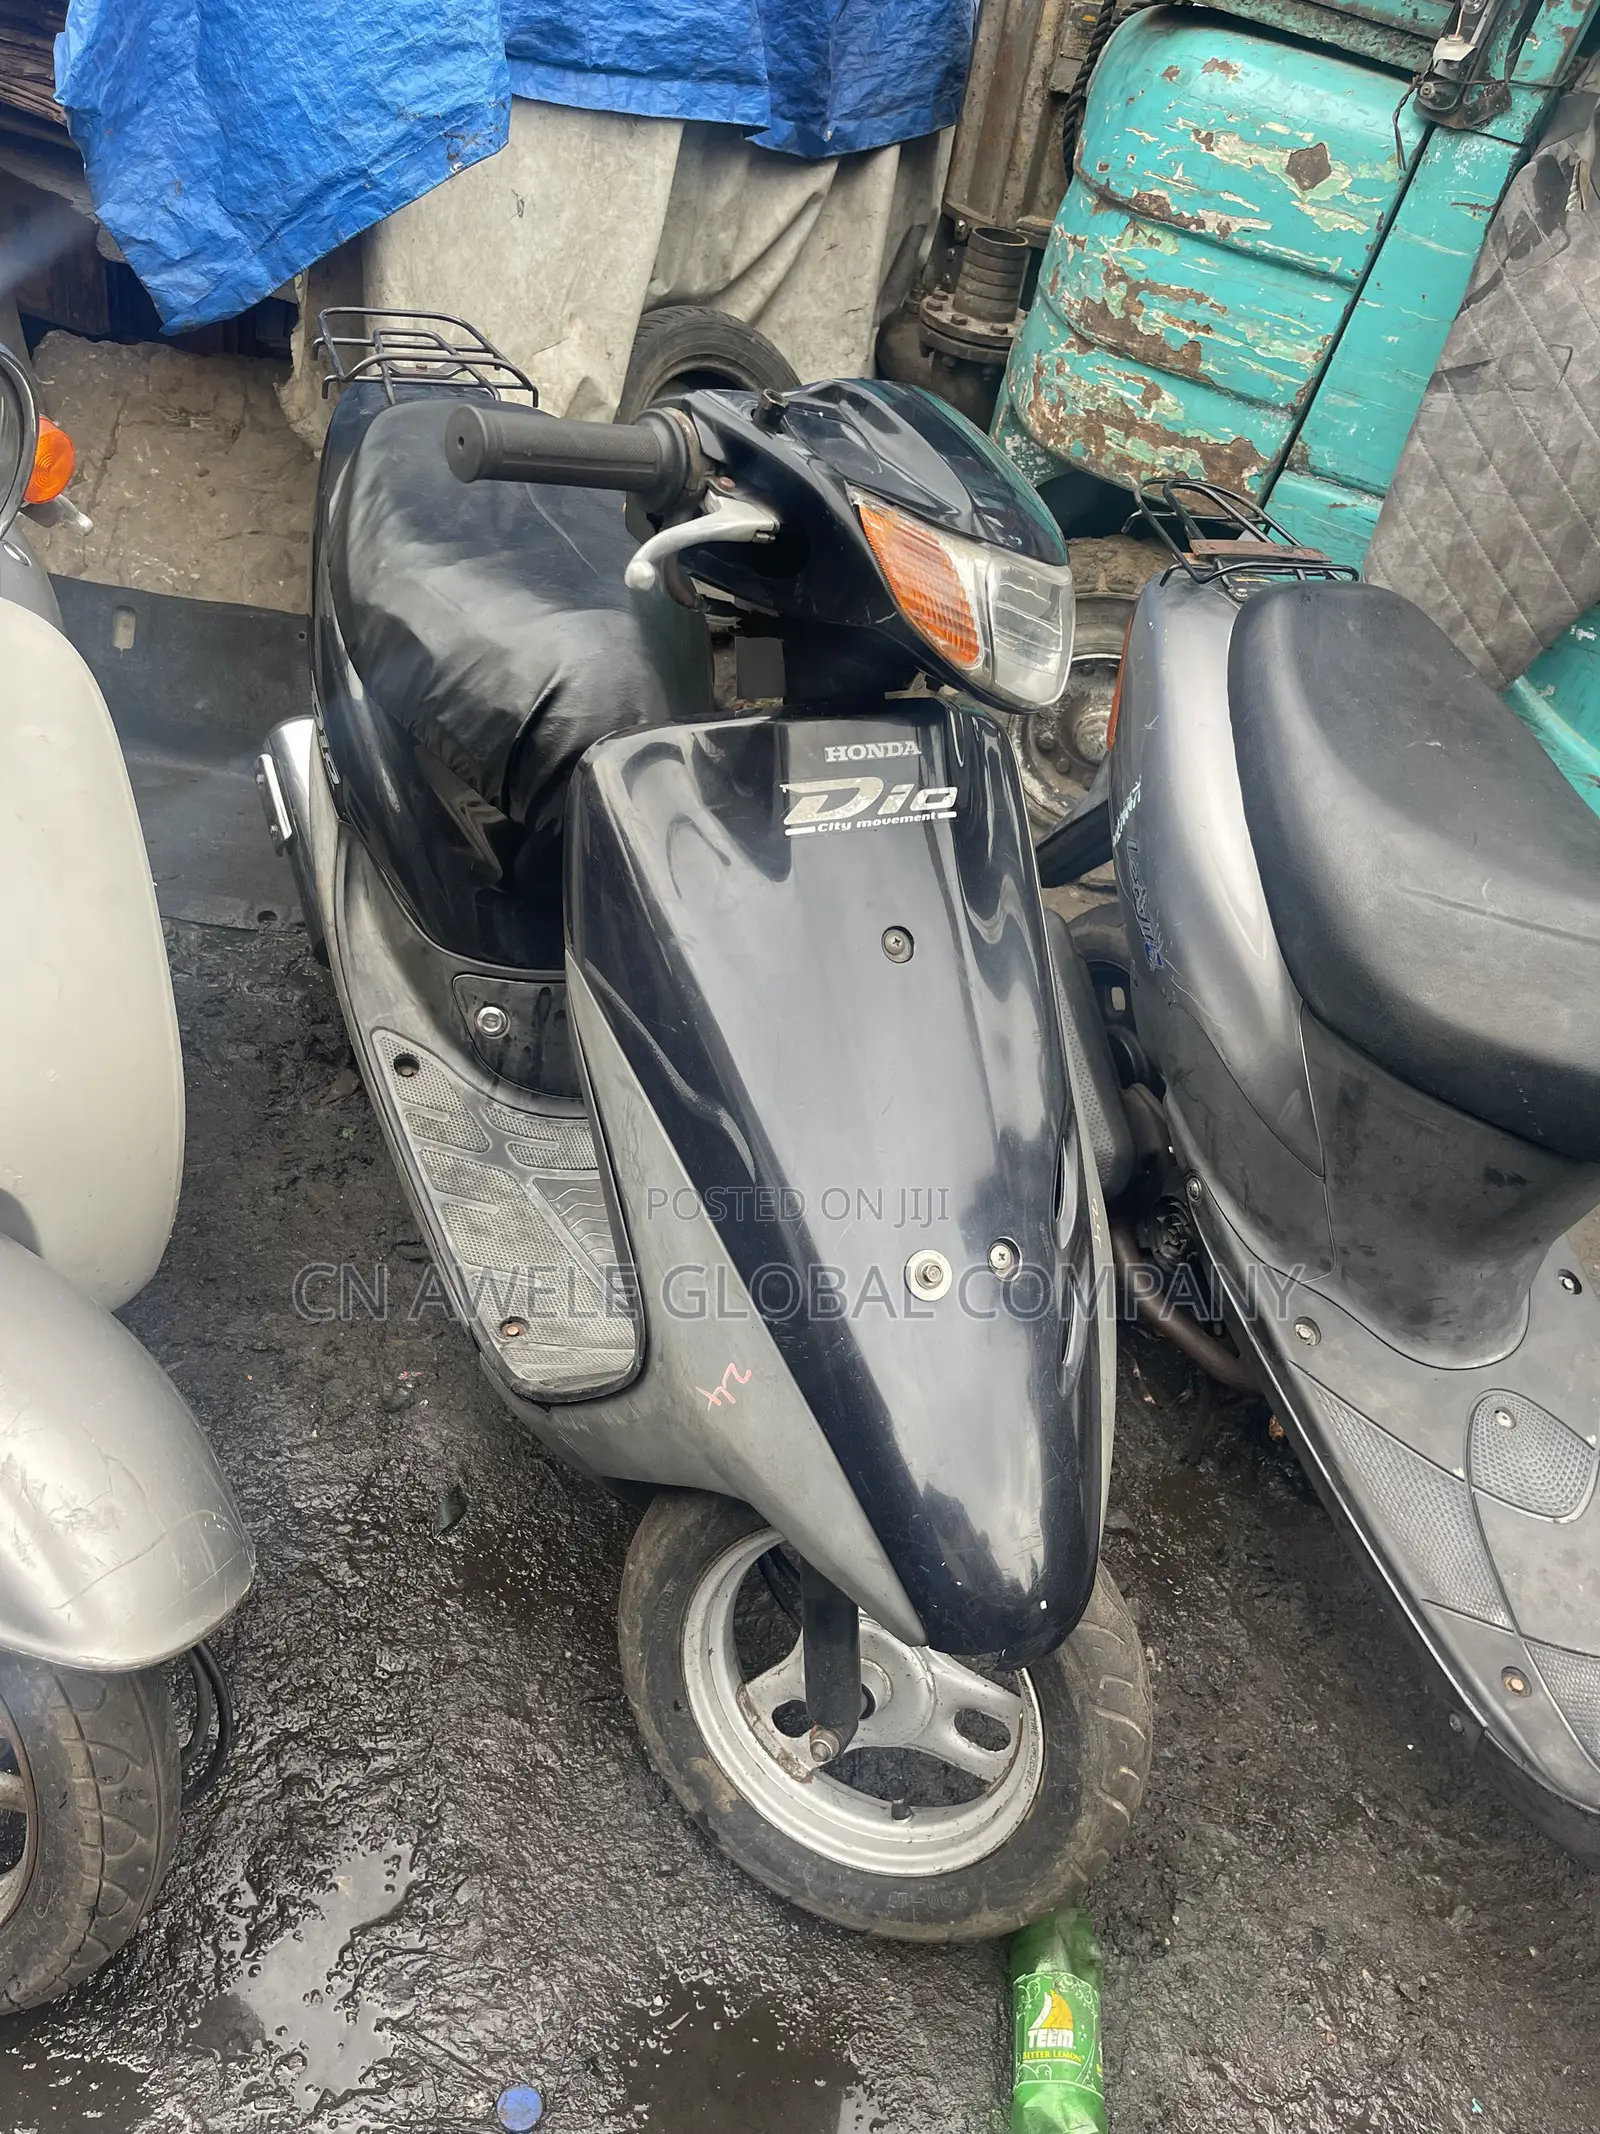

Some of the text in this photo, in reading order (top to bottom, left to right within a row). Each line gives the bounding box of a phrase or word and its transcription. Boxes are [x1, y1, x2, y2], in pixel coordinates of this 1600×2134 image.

[824, 741, 922, 763] HONDA
[779, 776, 957, 825] Dio
[856, 811, 936, 829] movement
[1028, 2029, 1074, 2049] TEEM
[1053, 2050, 1081, 2062] LEMON
